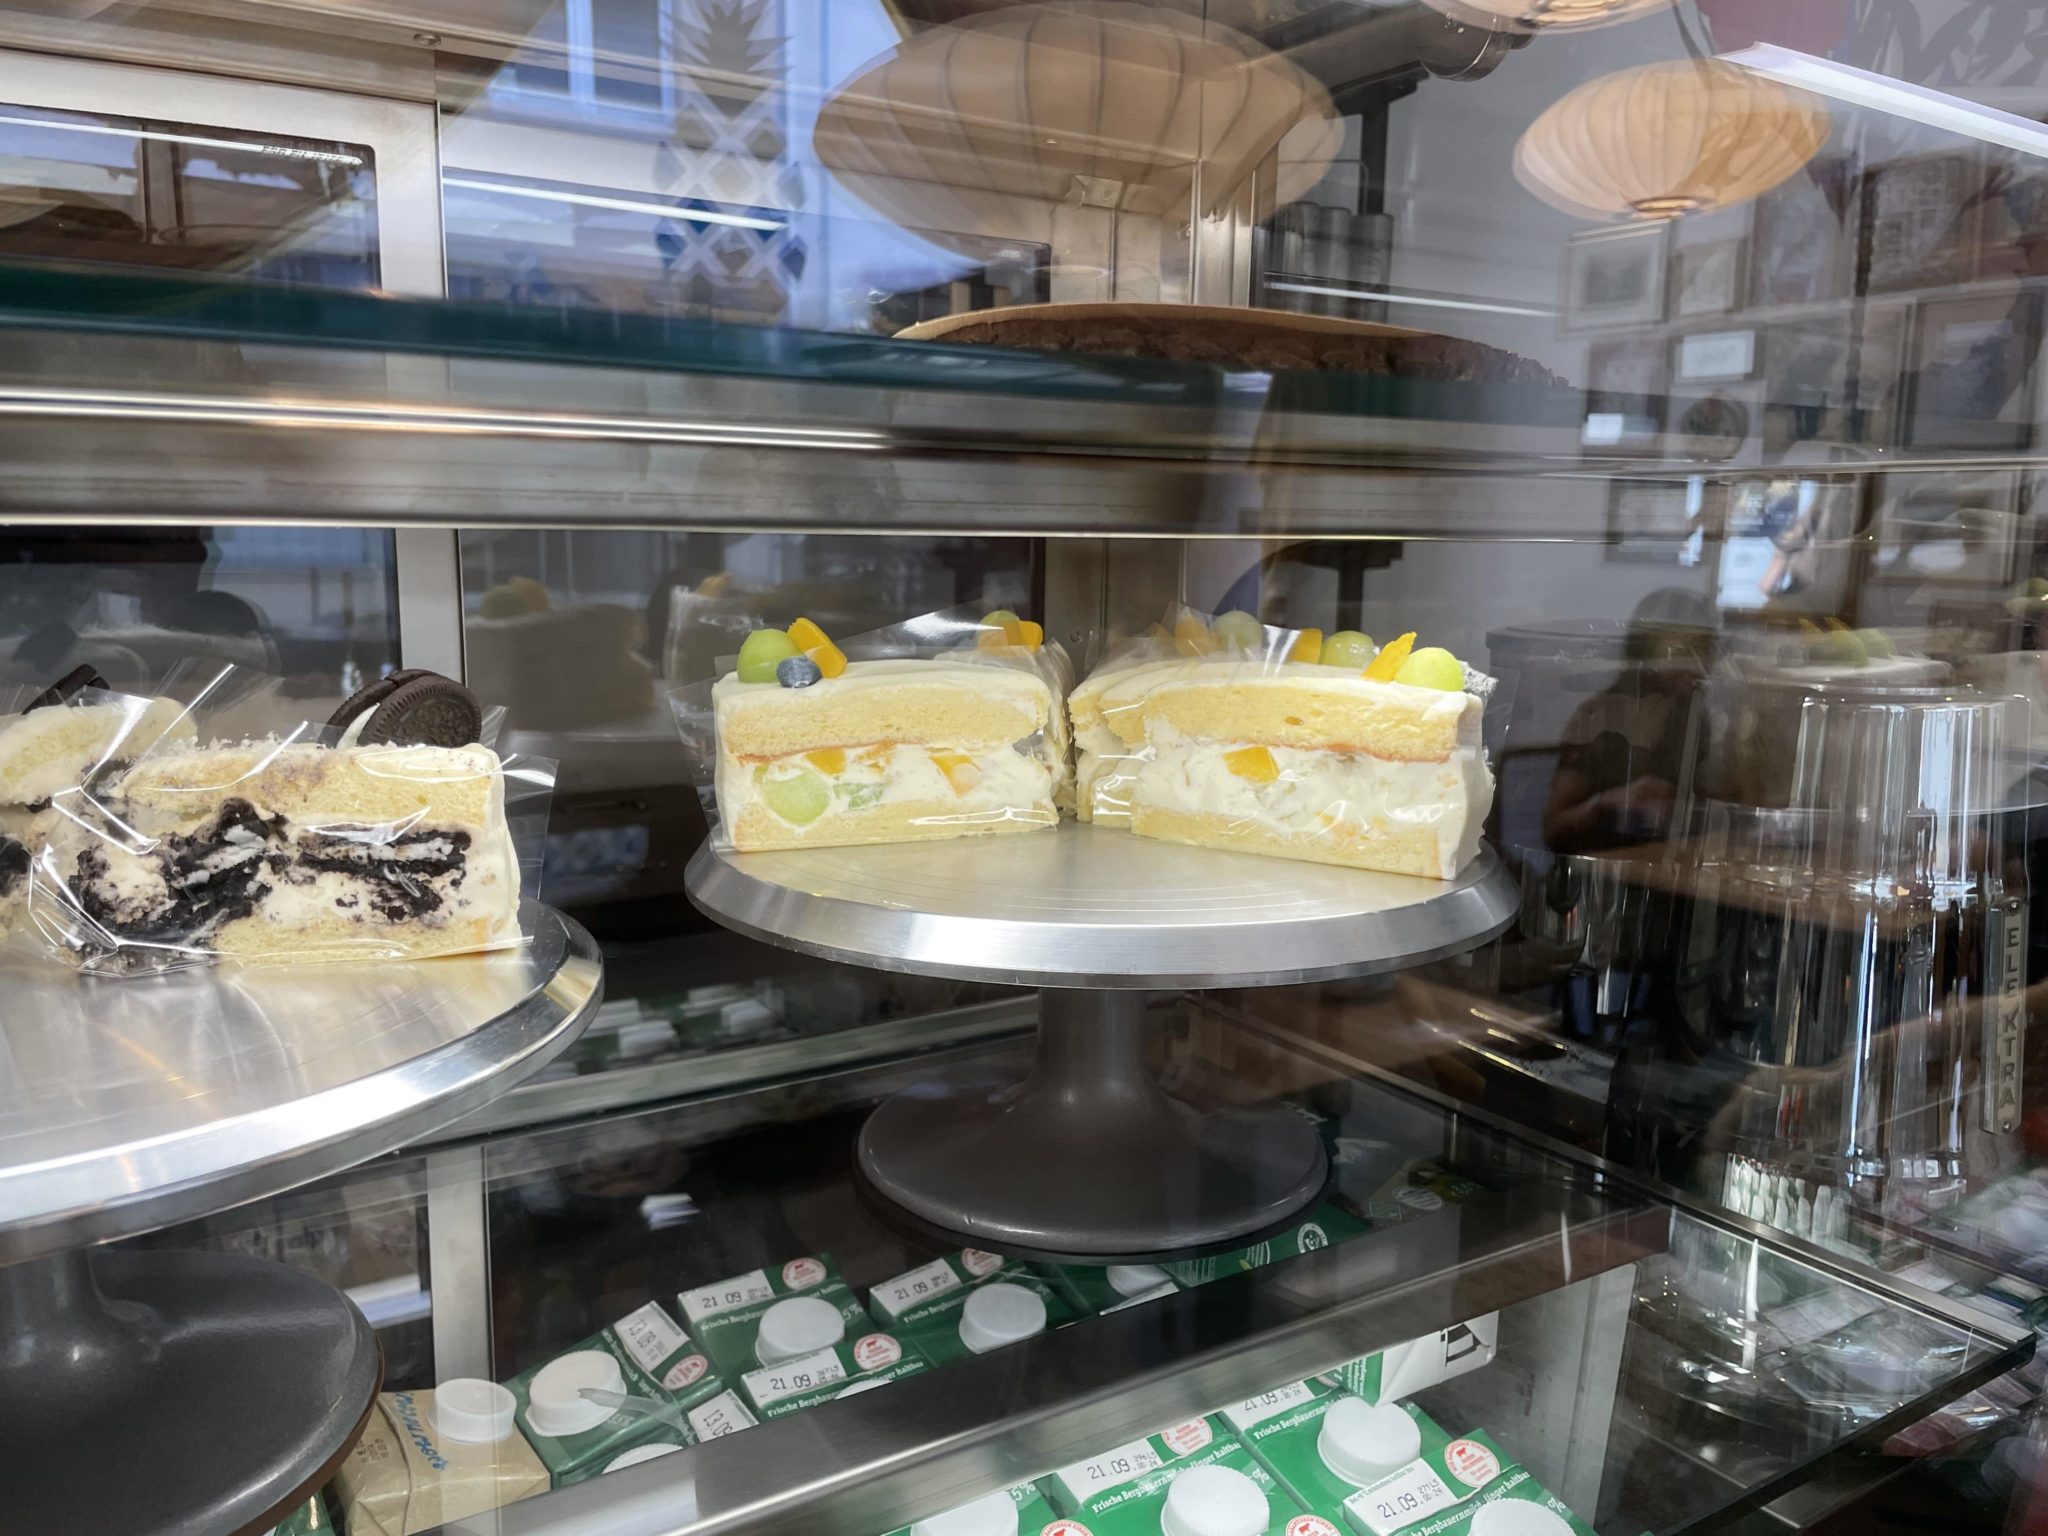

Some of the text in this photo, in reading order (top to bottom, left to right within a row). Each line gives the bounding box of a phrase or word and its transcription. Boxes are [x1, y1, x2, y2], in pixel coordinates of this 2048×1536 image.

[2000, 926, 2020, 1109] ELEKTRA
[767, 1401, 799, 1418] Frische
[1253, 1422, 1282, 1440] Frische
[1091, 1493, 1123, 1514] Frische
[1213, 1441, 1242, 1459] haltbar
[1503, 1471, 1531, 1493] haltbar
